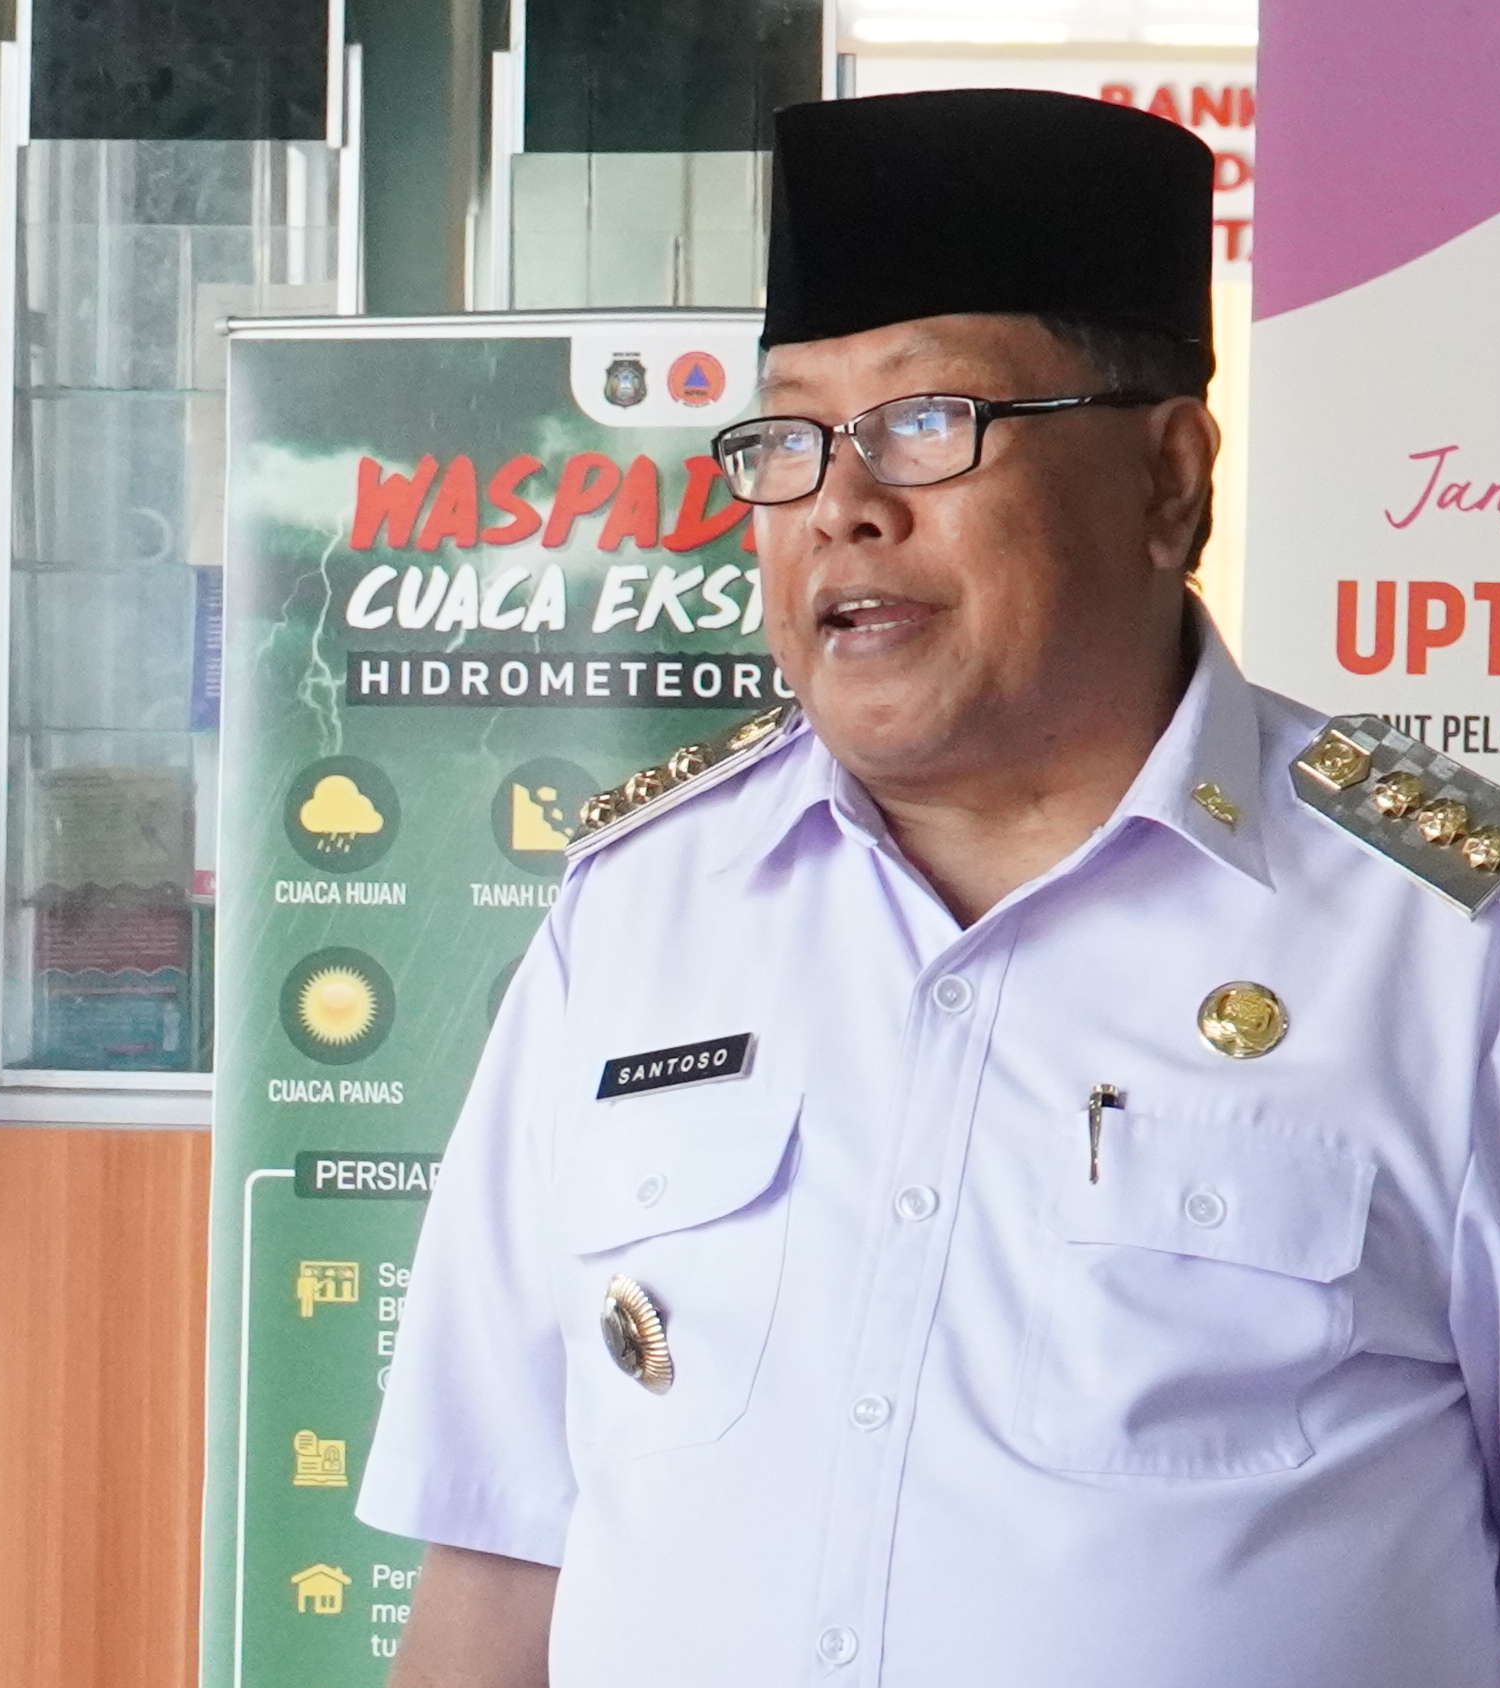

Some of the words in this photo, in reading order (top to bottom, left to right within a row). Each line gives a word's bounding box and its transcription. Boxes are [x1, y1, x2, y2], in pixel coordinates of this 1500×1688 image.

[349, 452, 757, 552] WASPAD
[345, 563, 566, 632] CUACA
[275, 880, 341, 905] CUACA
[345, 882, 407, 906] HUJAN
[470, 884, 534, 908] TANAH
[538, 884, 561, 908] LO
[618, 1047, 729, 1086] SANTOSO
[268, 1080, 336, 1104] CUACA
[339, 1081, 404, 1105] PANAS
